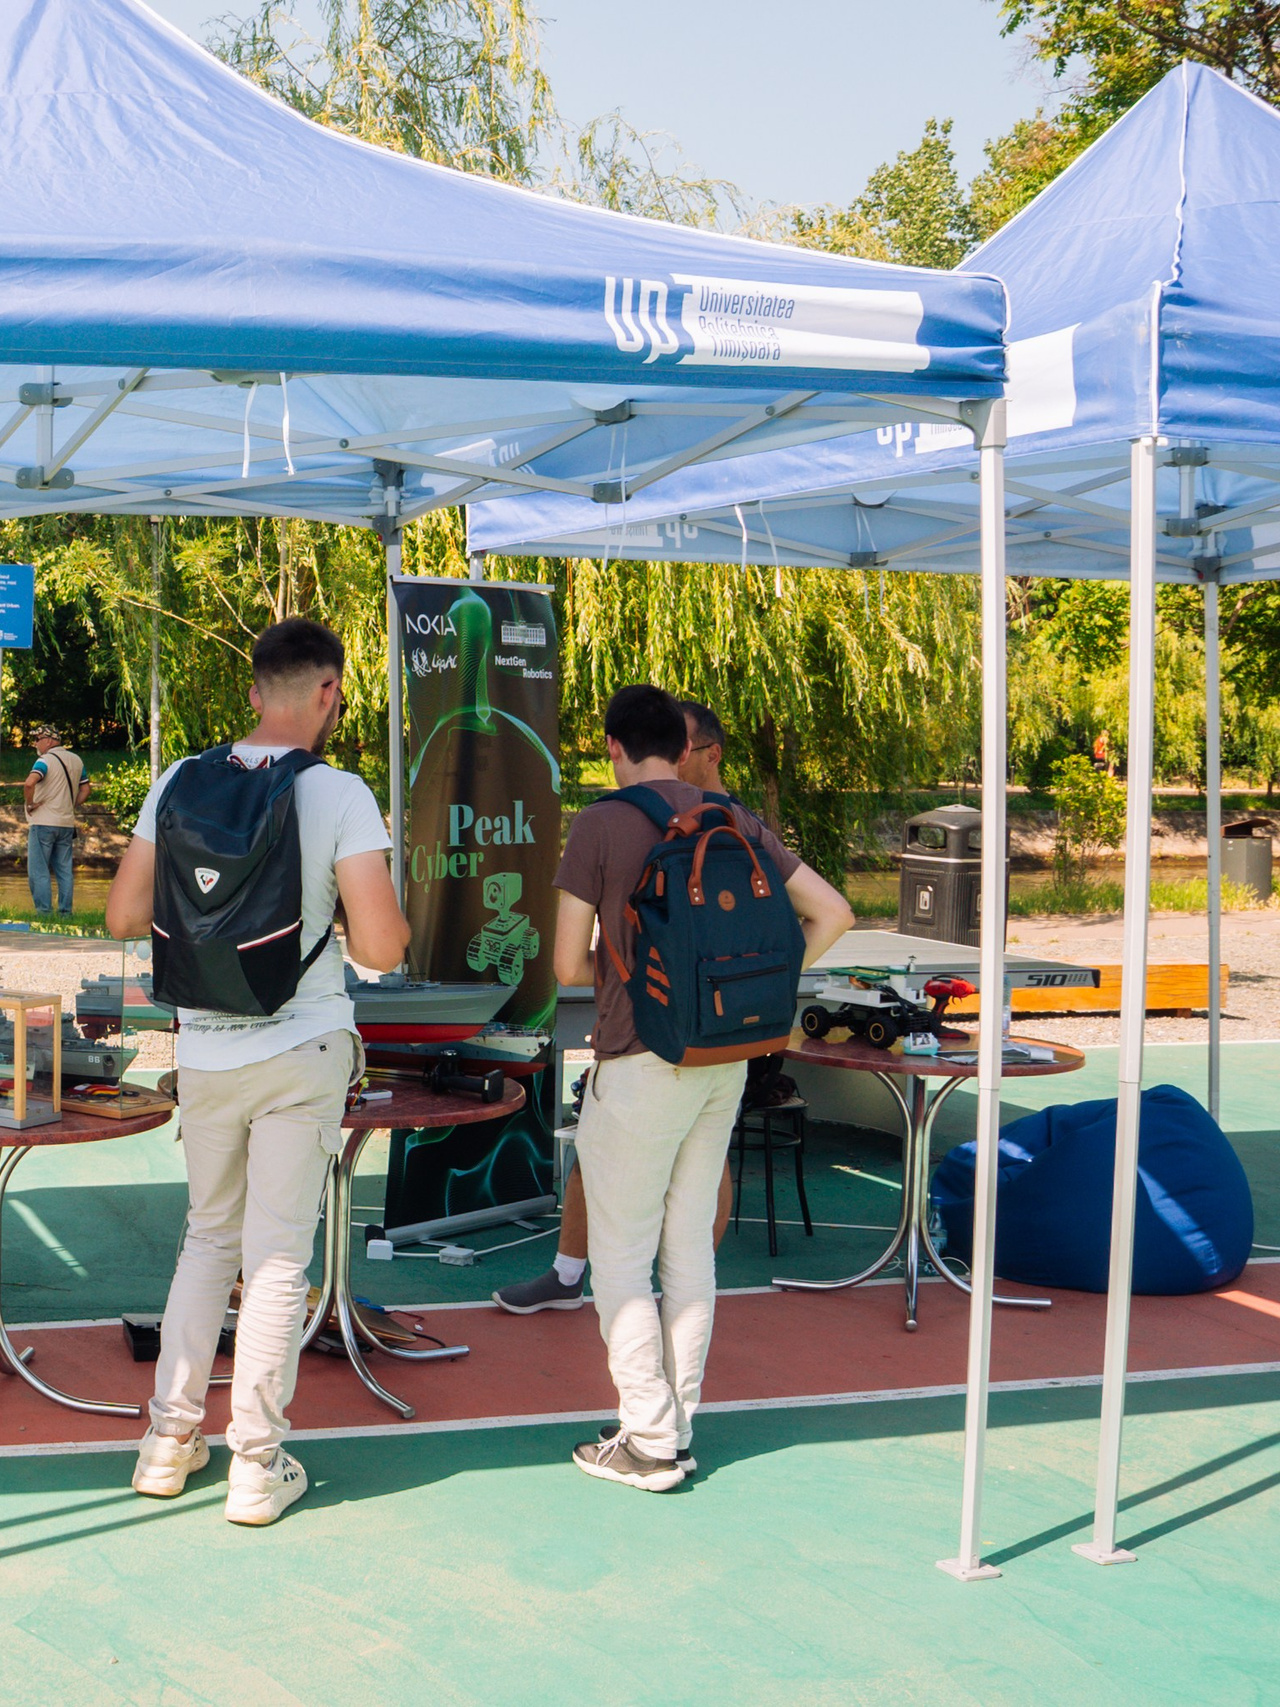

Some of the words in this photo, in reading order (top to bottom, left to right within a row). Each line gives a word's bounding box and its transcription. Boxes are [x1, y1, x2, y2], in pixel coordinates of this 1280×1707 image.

[698, 285, 796, 320] Universitatea
[405, 613, 458, 637] NOKIA
[494, 655, 528, 668] NextGen
[522, 667, 554, 681] Robotics
[447, 799, 536, 848] Peak
[410, 840, 485, 894] Cyber
